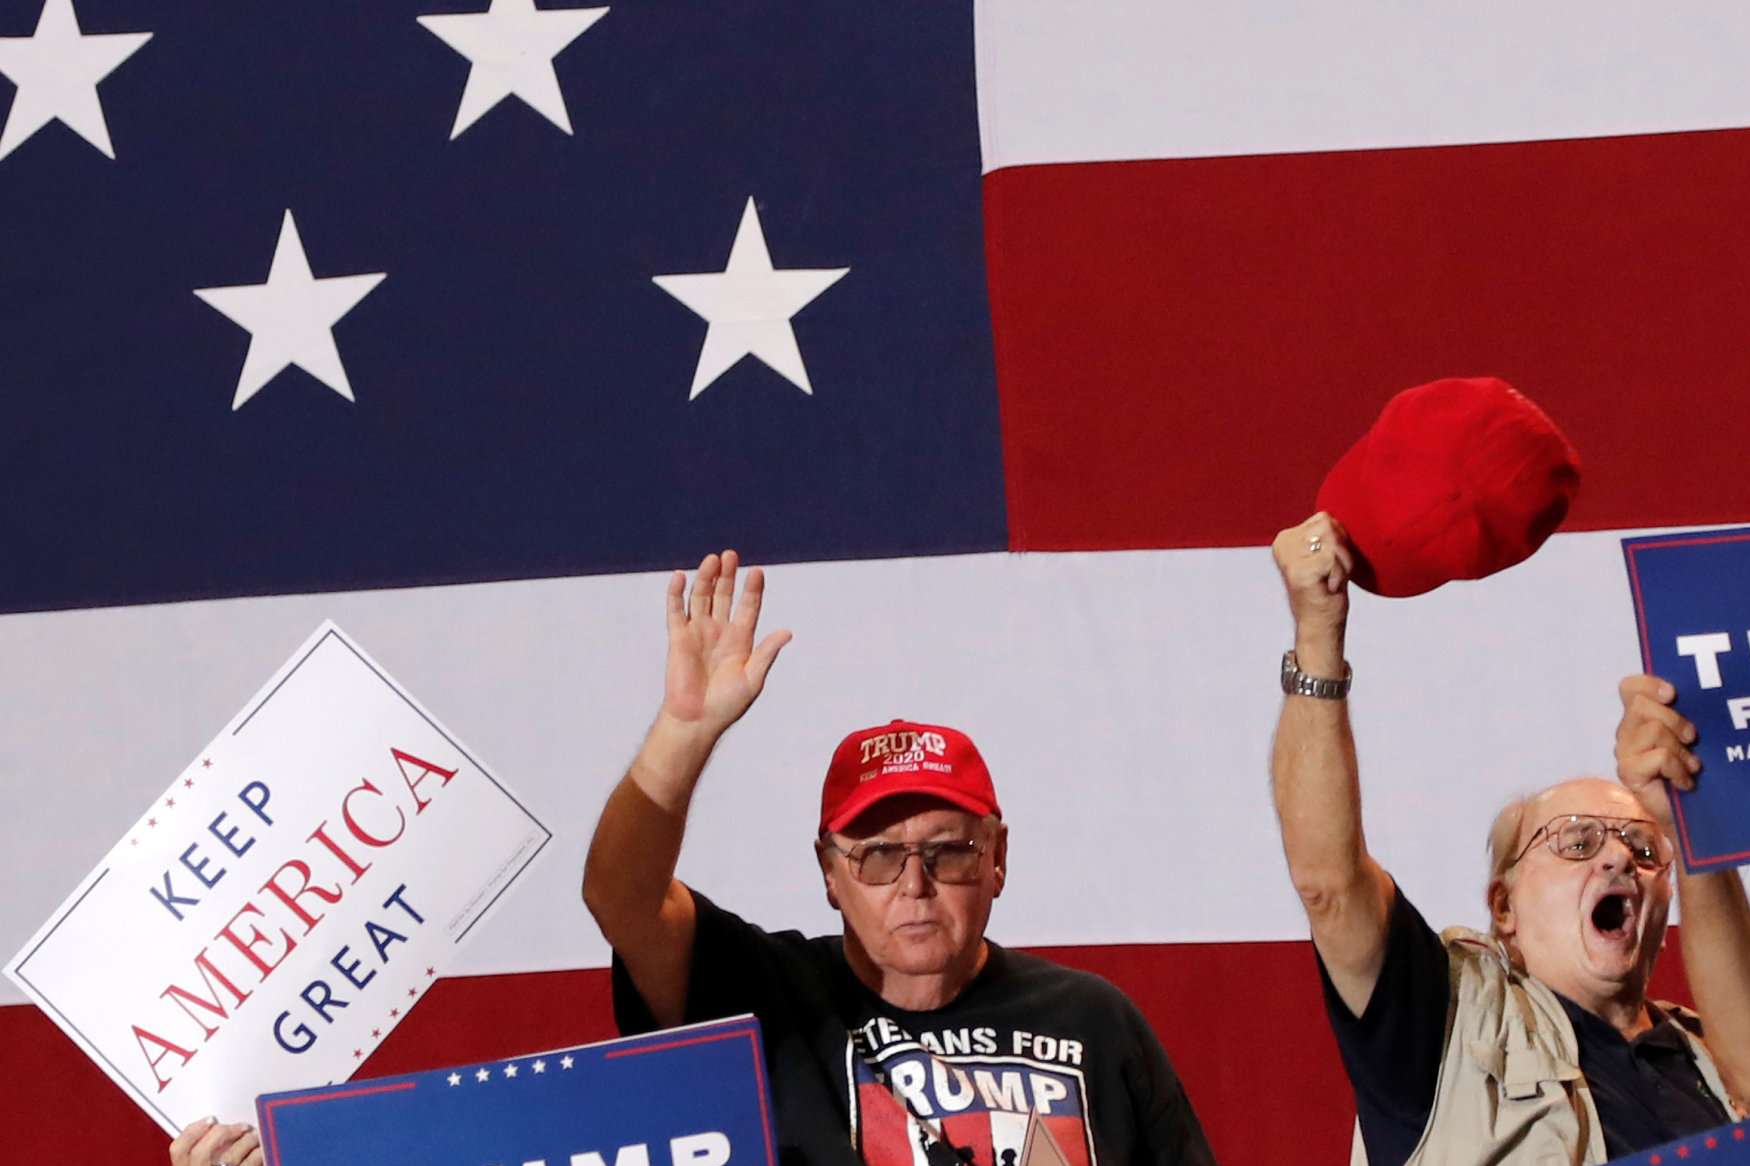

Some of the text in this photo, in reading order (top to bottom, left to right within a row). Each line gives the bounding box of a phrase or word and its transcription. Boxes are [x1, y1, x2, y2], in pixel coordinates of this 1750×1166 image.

[860, 732, 946, 764] TRUMP
[883, 750, 925, 765] 2020
[149, 780, 273, 921] KEEP
[131, 746, 459, 1093] AMERICA
[273, 883, 424, 1054] GREAT
[1012, 1030, 1083, 1065] FOR
[878, 1060, 1067, 1117] RUMP
